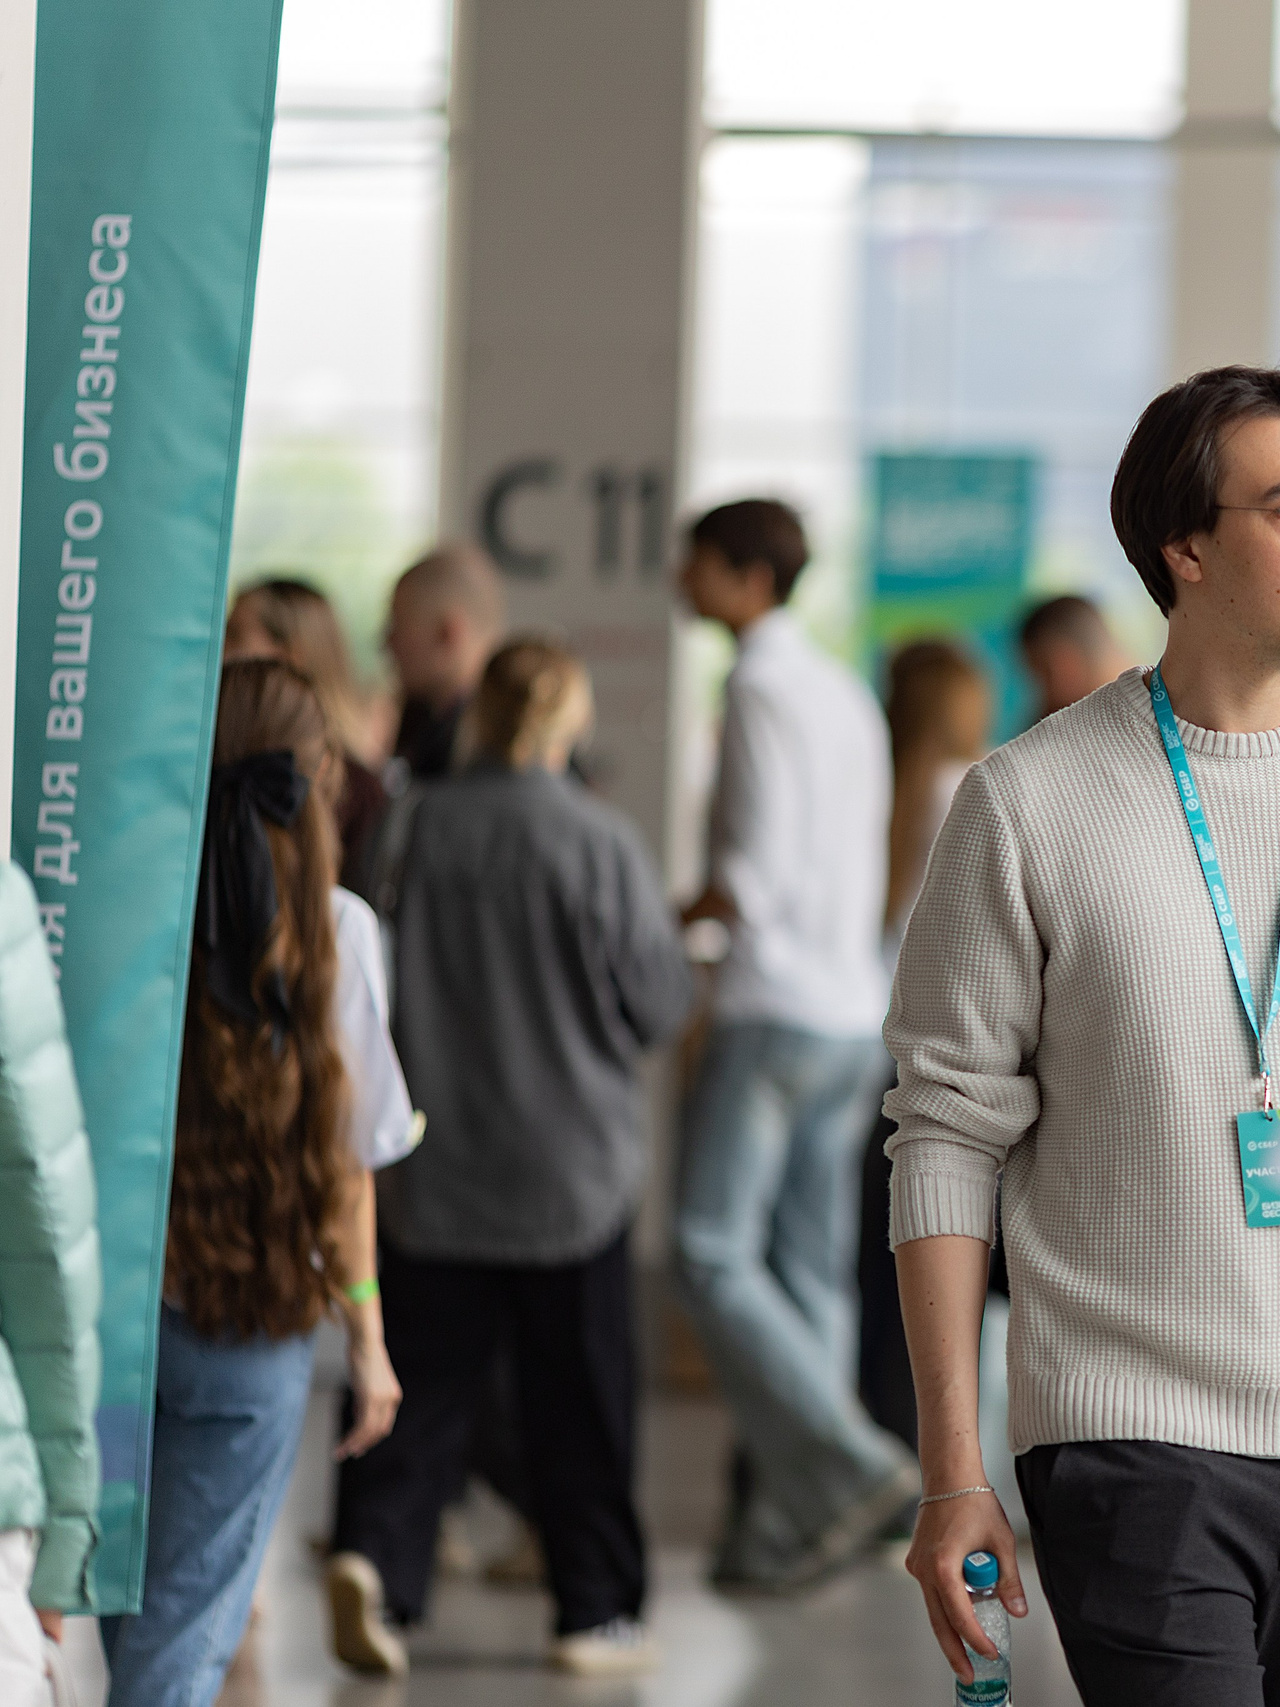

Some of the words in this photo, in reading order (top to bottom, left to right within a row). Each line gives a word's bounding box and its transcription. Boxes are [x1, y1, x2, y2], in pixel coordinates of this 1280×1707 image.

[53, 213, 132, 483] бизнеса
[46, 499, 104, 741] вашего
[34, 761, 80, 886] для
[1178, 770, 1194, 797] СБЕР
[1213, 884, 1228, 912] СБЕР
